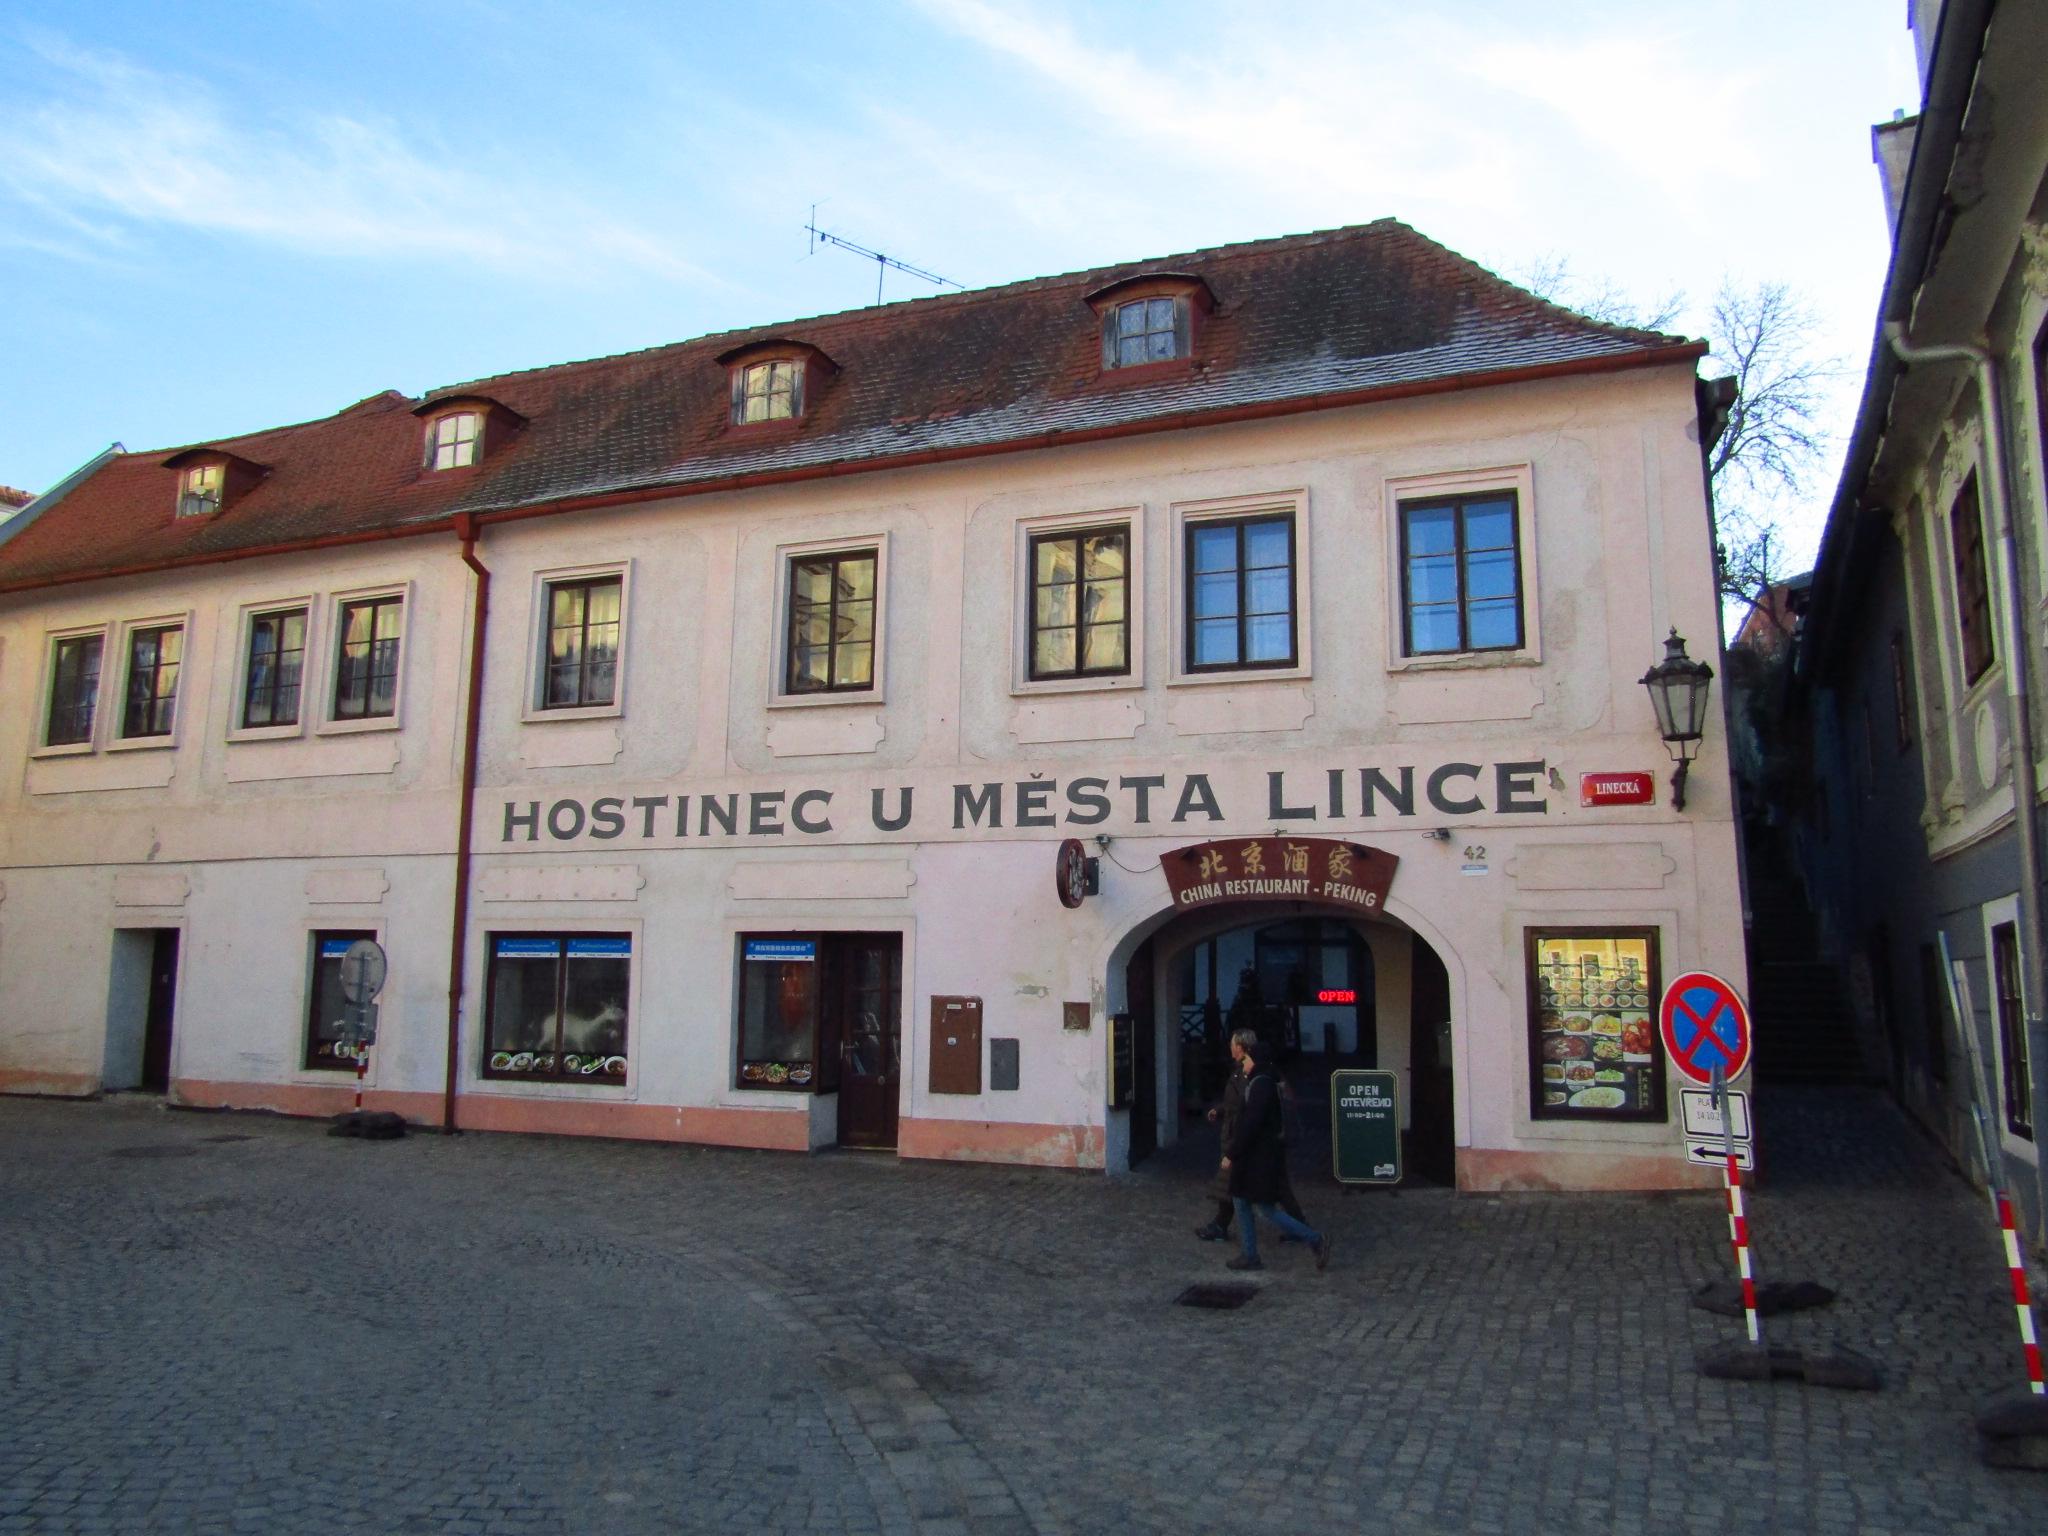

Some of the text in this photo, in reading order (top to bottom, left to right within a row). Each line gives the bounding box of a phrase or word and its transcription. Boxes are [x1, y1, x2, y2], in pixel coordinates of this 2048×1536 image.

[1596, 779, 1640, 795] LINECKÁ
[502, 758, 1547, 842] HOSTINEC U MĚSTA LINCE
[1200, 842, 1353, 879] 北京酒家
[1464, 846, 1486, 860] 42
[1181, 882, 1222, 904] CHINA
[1226, 879, 1310, 895] RESTAURANT
[1324, 881, 1377, 906] PEKING
[1319, 991, 1354, 1002] OPEN
[1349, 1085, 1379, 1095] OPEN
